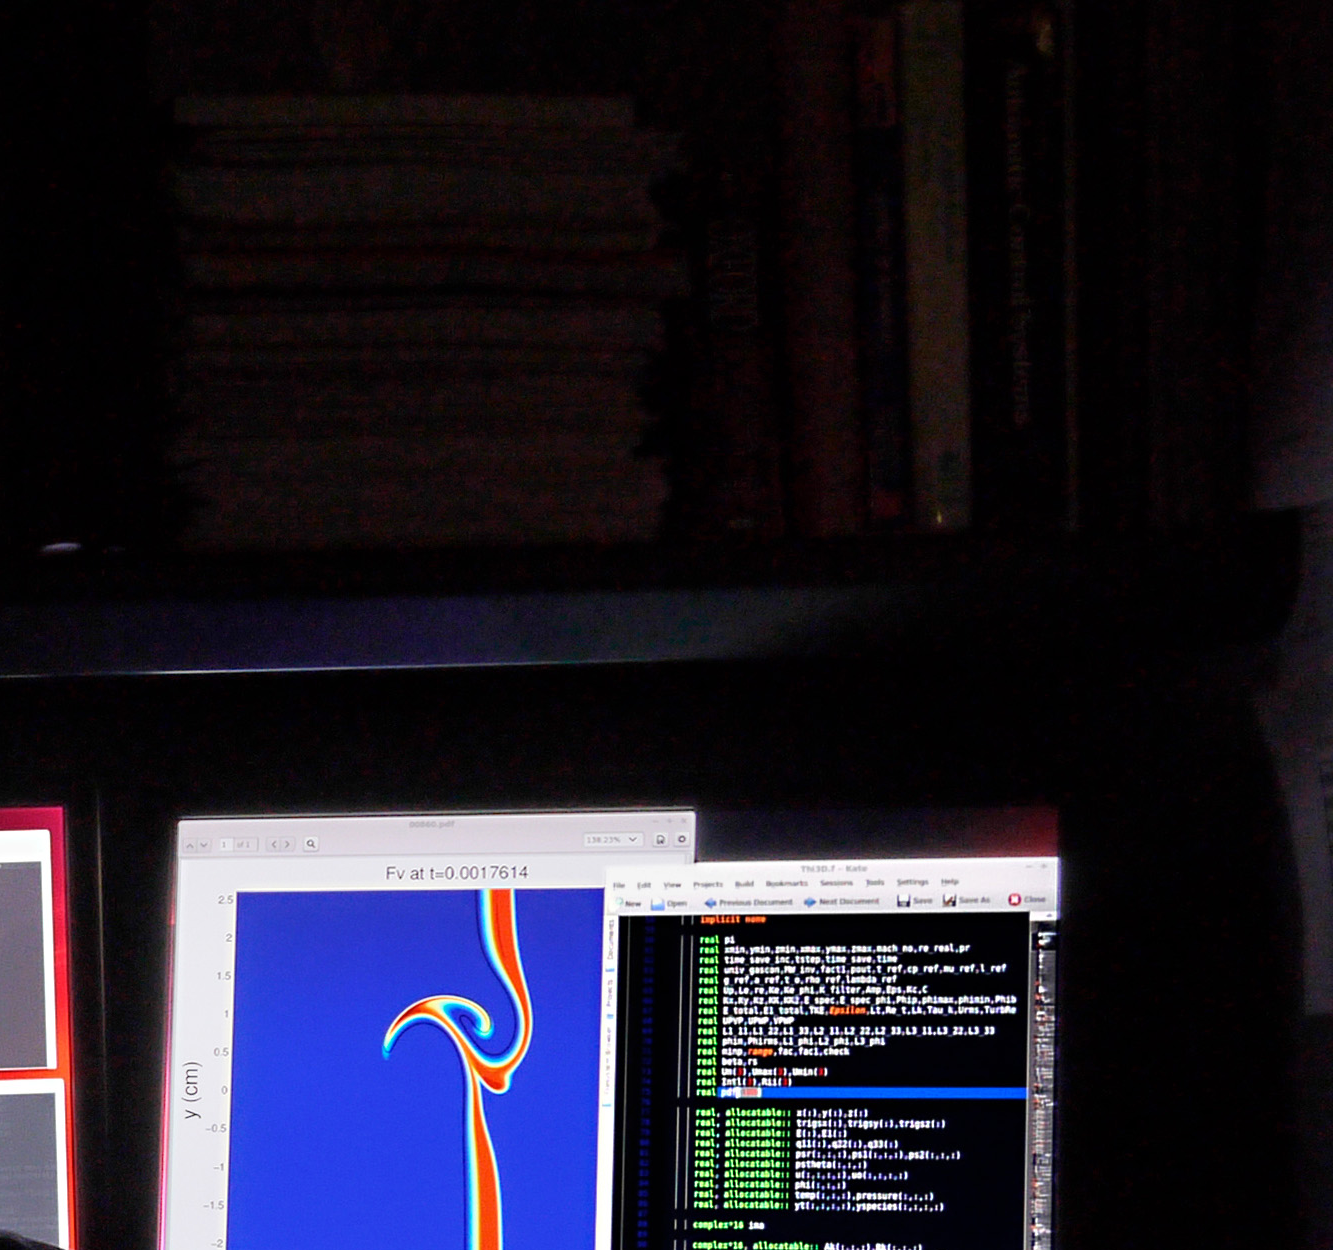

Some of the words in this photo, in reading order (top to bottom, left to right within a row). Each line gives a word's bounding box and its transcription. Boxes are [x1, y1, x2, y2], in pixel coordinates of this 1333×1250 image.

[385, 866, 405, 880] Fv
[409, 867, 425, 880] at
[429, 865, 529, 881] t=0.0017614
[612, 881, 626, 890] File
[636, 881, 652, 890] Edit
[663, 881, 682, 890] View
[693, 880, 724, 890] Projects
[735, 880, 754, 889] Build
[765, 879, 808, 889] Bookmarks
[820, 879, 853, 887] Sessions
[865, 878, 885, 887] Tools
[896, 878, 929, 888] Settings
[941, 877, 959, 887] Help
[218, 895, 234, 905] 2.5
[625, 900, 642, 908] New
[667, 899, 687, 909] Open
[719, 899, 751, 907] Previous
[754, 898, 793, 907] Document
[819, 897, 837, 906] Next
[839, 897, 880, 906] Document
[913, 896, 933, 905] Save
[959, 896, 981, 905] Save
[1023, 895, 1046, 904] Close
[700, 915, 741, 925] implicit
[744, 915, 767, 924] none
[225, 933, 233, 942] 2
[699, 934, 720, 944] real
[724, 935, 736, 945] pi
[699, 944, 720, 954] real
[699, 955, 720, 965] real
[216, 971, 232, 981] 1.5
[698, 1015, 718, 1025] real
[213, 1047, 230, 1057] 0.5
[181, 1061, 203, 1103] (cm)
[221, 1085, 229, 1095] 0
[184, 1109, 202, 1119] y
[696, 1108, 720, 1118] real,
[725, 1108, 791, 1118] allocatable::
[205, 1123, 227, 1133] -0.5
[696, 1118, 720, 1128] real,
[725, 1118, 791, 1128] allocatable::
[725, 1128, 791, 1138] allocatable::
[724, 1138, 790, 1148] allocatable::
[724, 1148, 790, 1158] allocatable::
[723, 1179, 789, 1189] allocatable::
[203, 1200, 225, 1210] -1.5
[210, 1239, 224, 1248] -2
